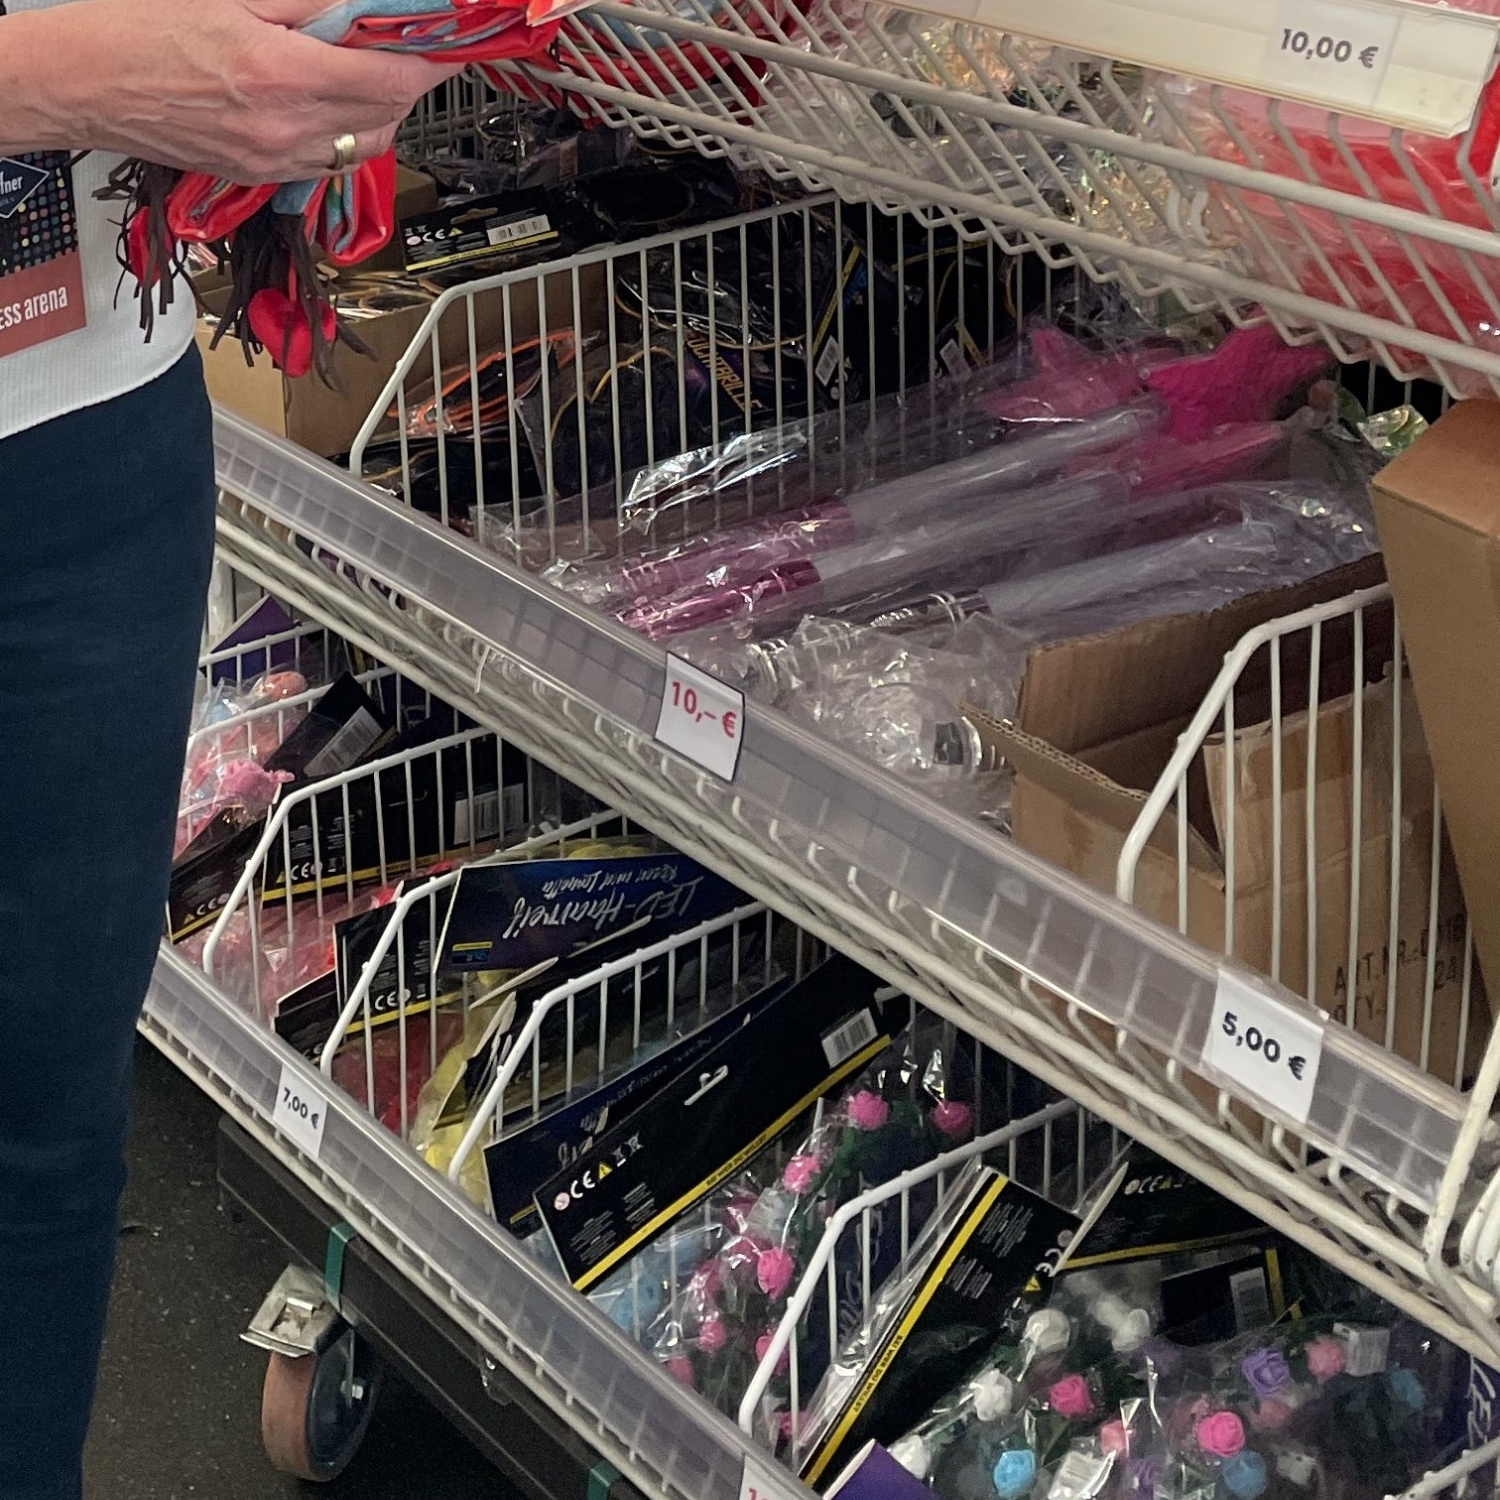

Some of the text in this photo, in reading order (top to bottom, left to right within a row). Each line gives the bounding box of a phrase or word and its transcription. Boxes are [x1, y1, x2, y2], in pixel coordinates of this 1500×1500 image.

[1281, 28, 1379, 69] 10,00 €
[23, 286, 68, 320] arena
[722, 711, 737, 739] €
[1222, 1011, 1306, 1081] 5,00 €
[284, 1087, 319, 1129] 7,00 €
